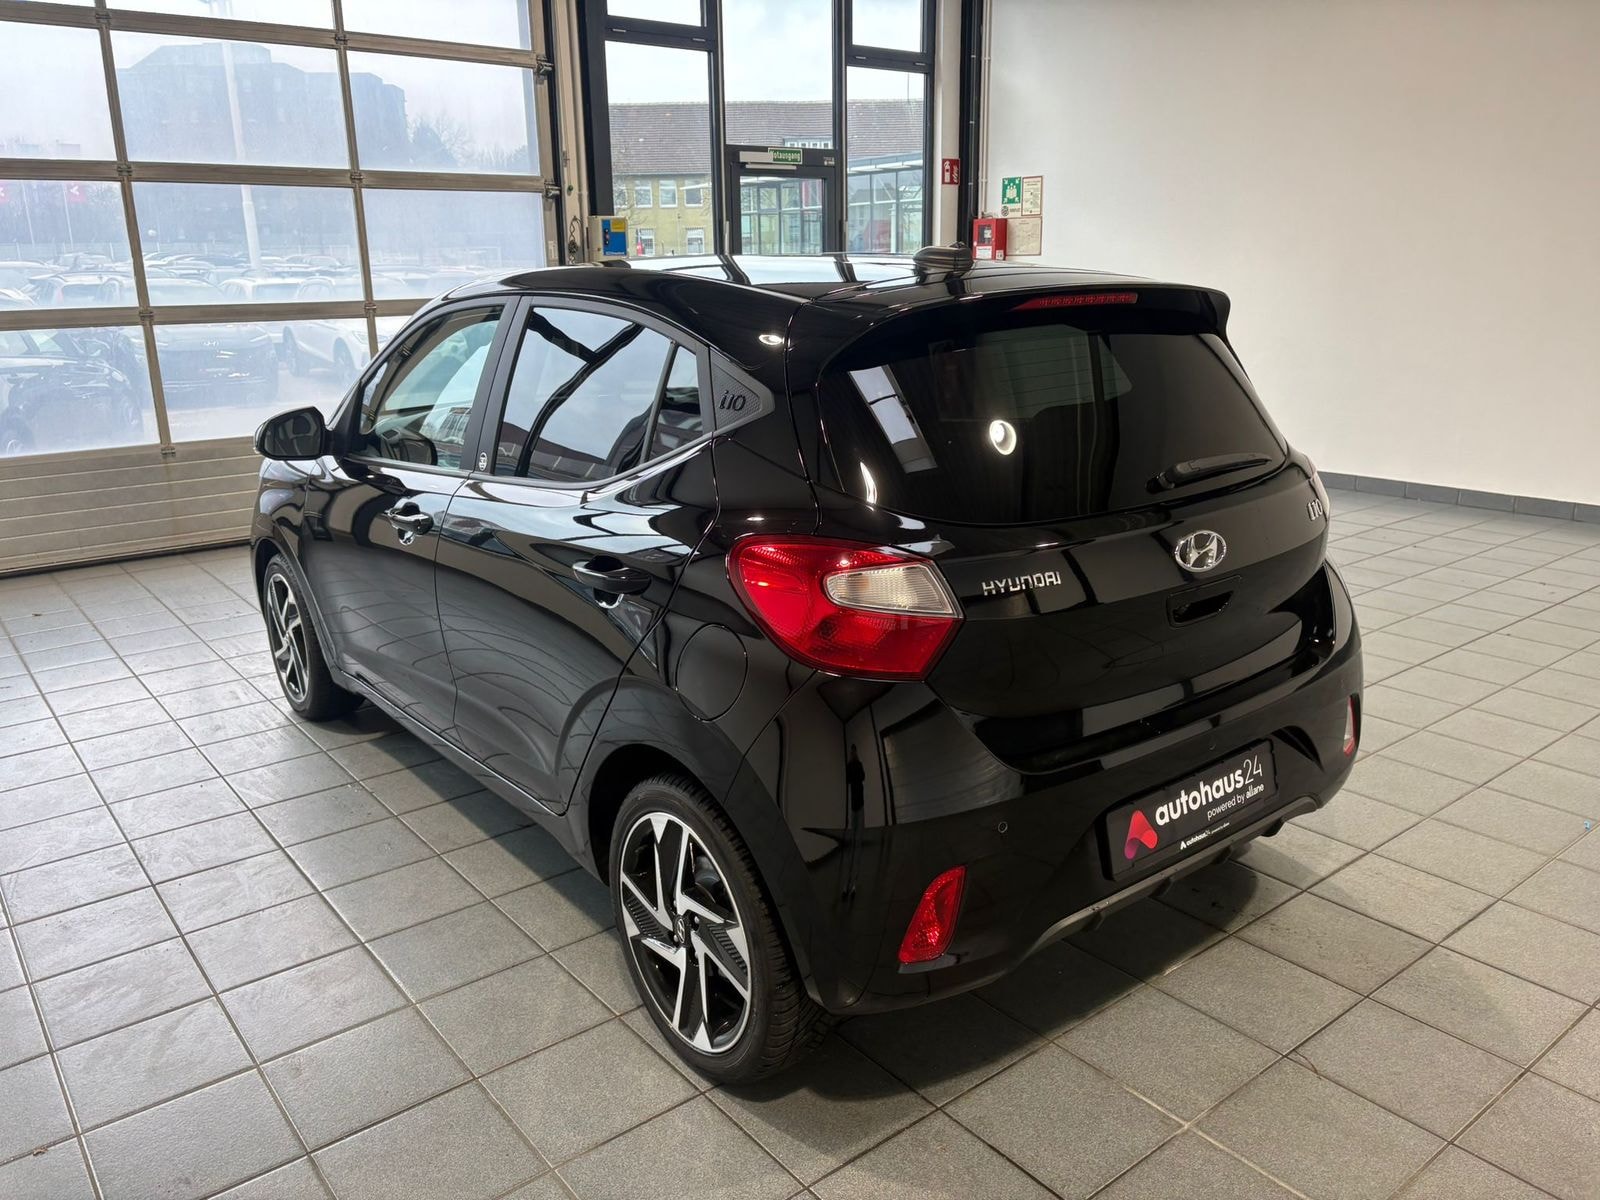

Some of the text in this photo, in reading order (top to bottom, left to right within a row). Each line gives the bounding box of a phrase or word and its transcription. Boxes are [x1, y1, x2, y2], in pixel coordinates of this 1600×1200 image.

[719, 390, 746, 411] i10
[981, 571, 1062, 596] HYUNDAI
[1155, 755, 1263, 826] autohaus24
[1207, 795, 1236, 821] powered
[1237, 792, 1245, 804] by
